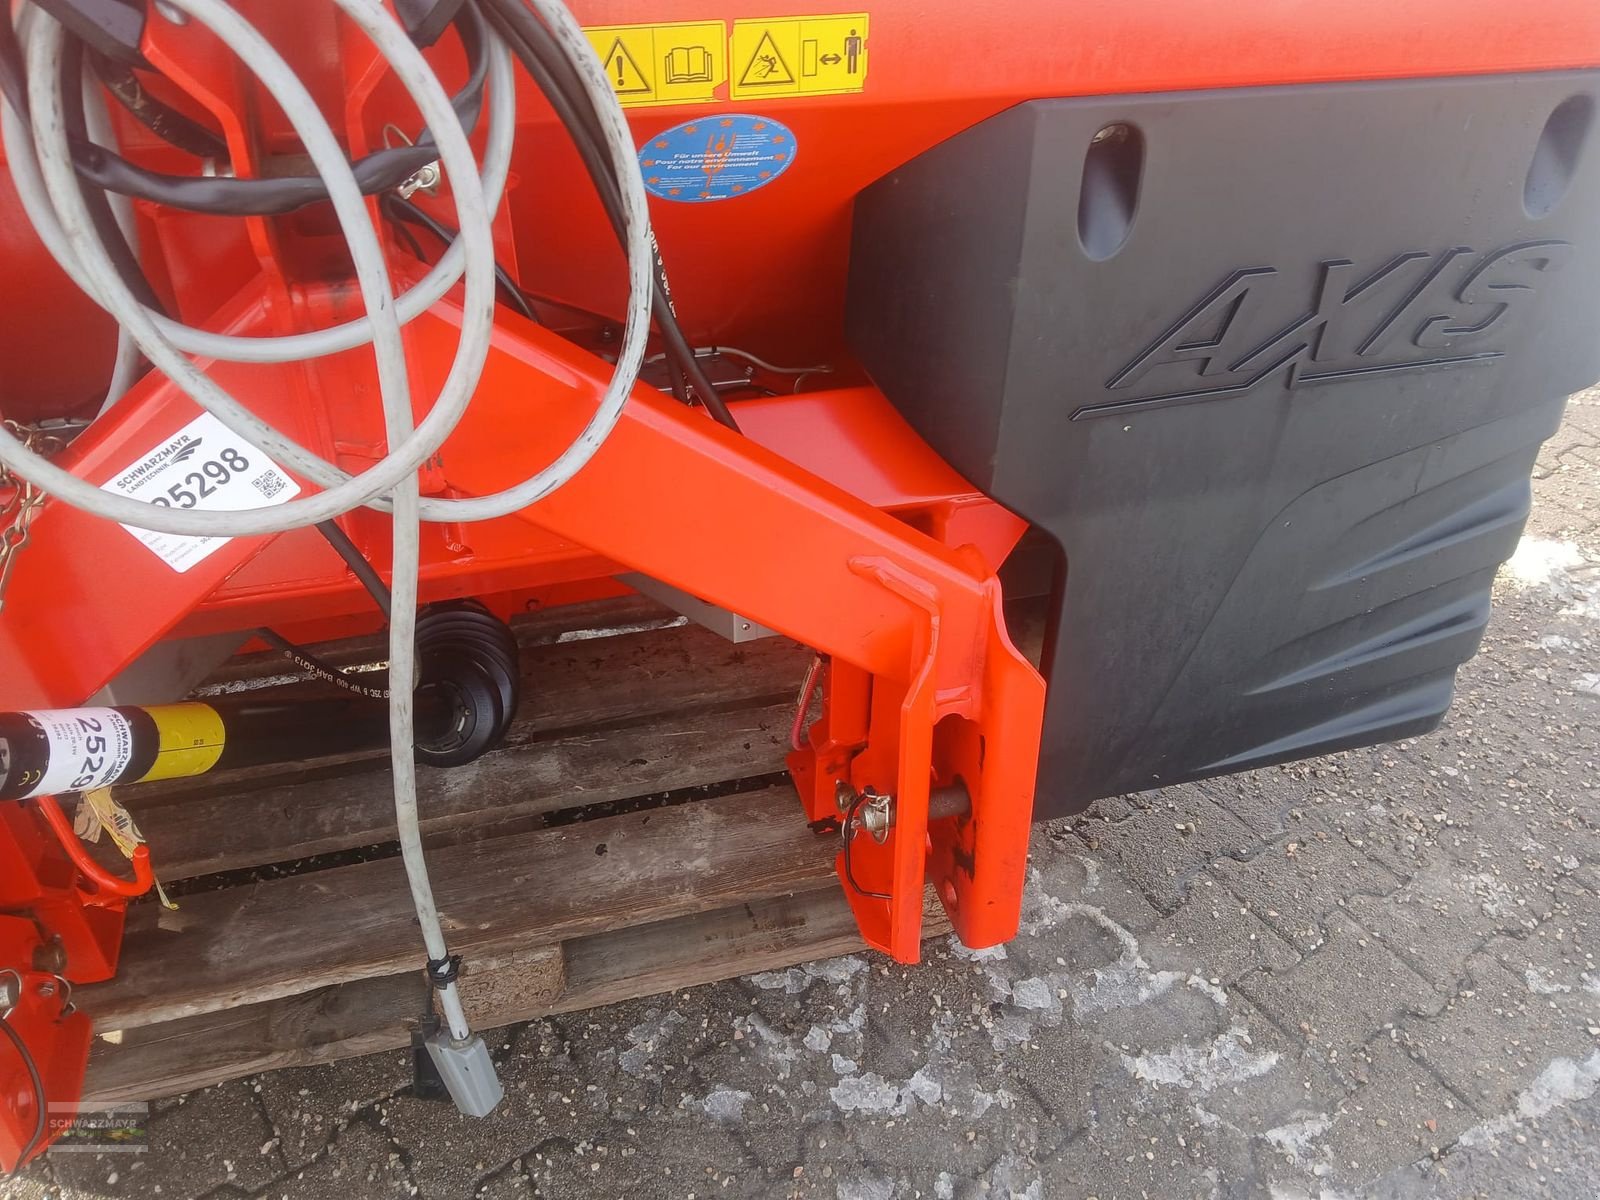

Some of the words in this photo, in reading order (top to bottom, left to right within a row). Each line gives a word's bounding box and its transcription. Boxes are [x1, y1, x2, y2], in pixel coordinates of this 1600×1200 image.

[701, 161, 760, 169] environment
[704, 155, 775, 164] environnement
[1104, 239, 1574, 390] AXIS
[117, 434, 191, 489] SCHWARZMAYR
[126, 463, 171, 494] LANDTECHNIK
[62, 717, 107, 793] 2529
